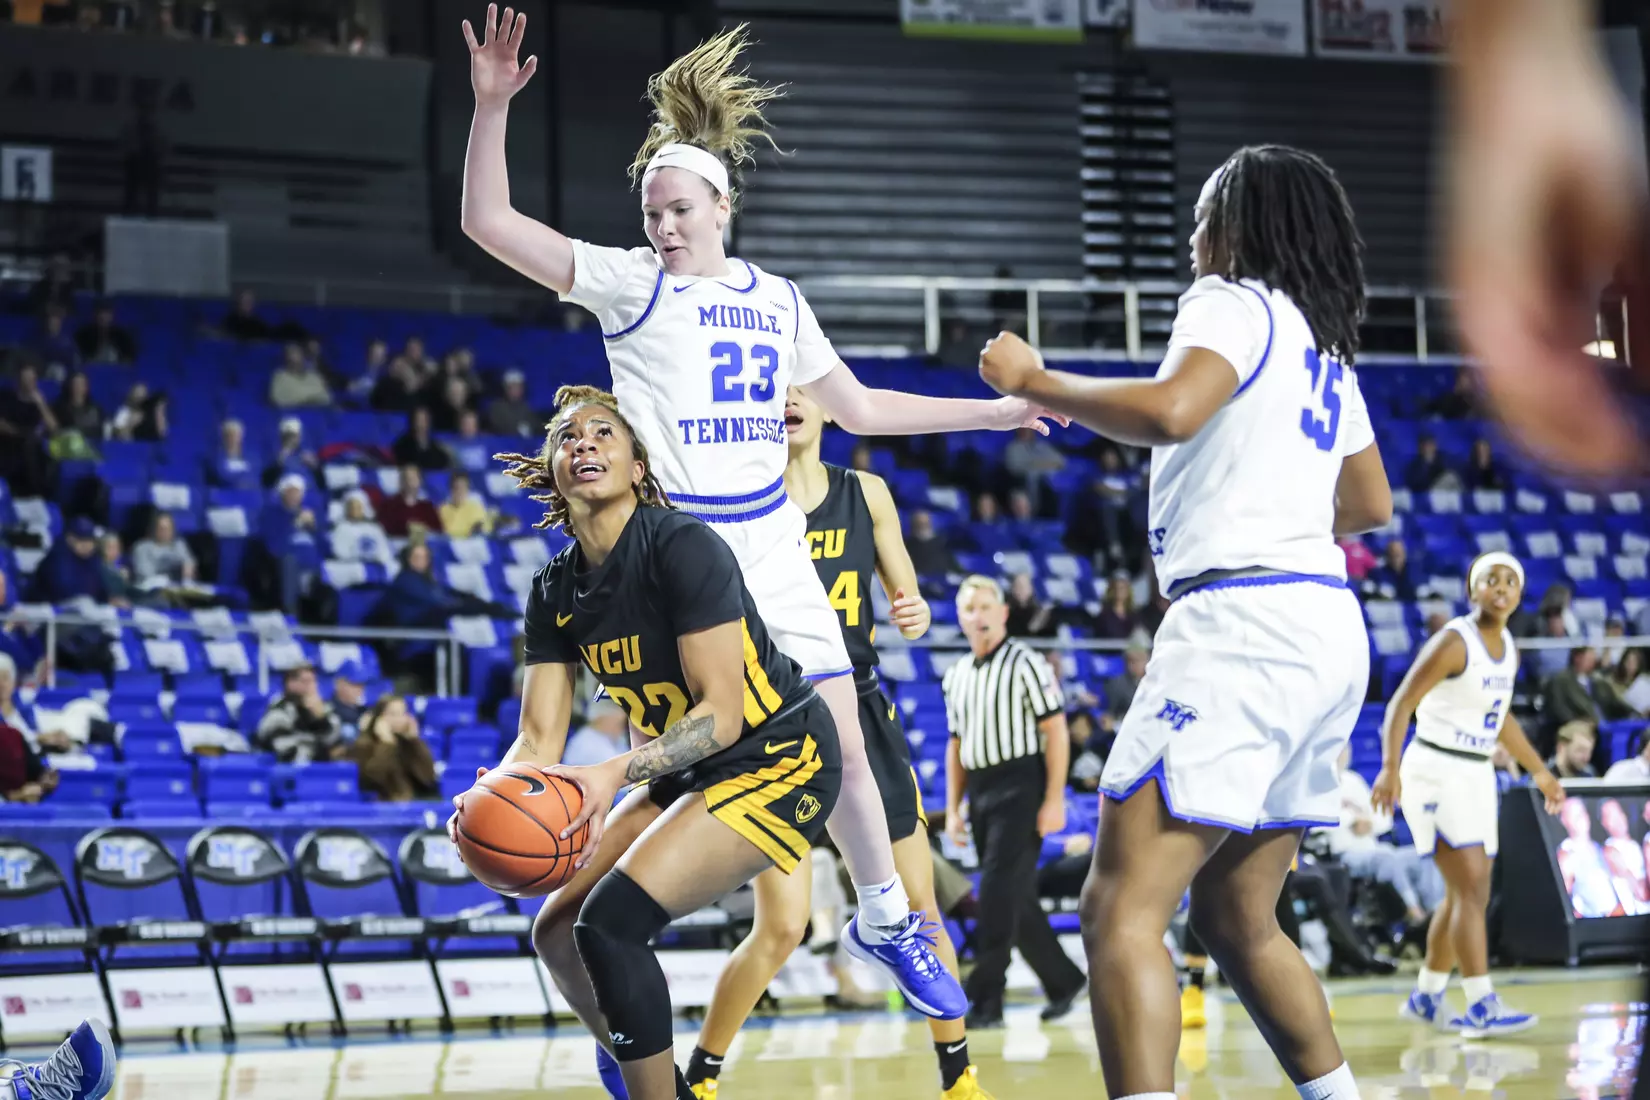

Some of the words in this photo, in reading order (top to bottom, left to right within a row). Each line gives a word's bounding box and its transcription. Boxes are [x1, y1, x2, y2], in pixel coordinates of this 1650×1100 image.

[698, 304, 782, 336] MIDDLE
[710, 341, 779, 403] 23
[1300, 346, 1344, 452] 35
[804, 528, 847, 560] CU
[579, 635, 642, 674] VCU
[1482, 675, 1514, 691] MIDDL
[606, 682, 689, 738] 22
